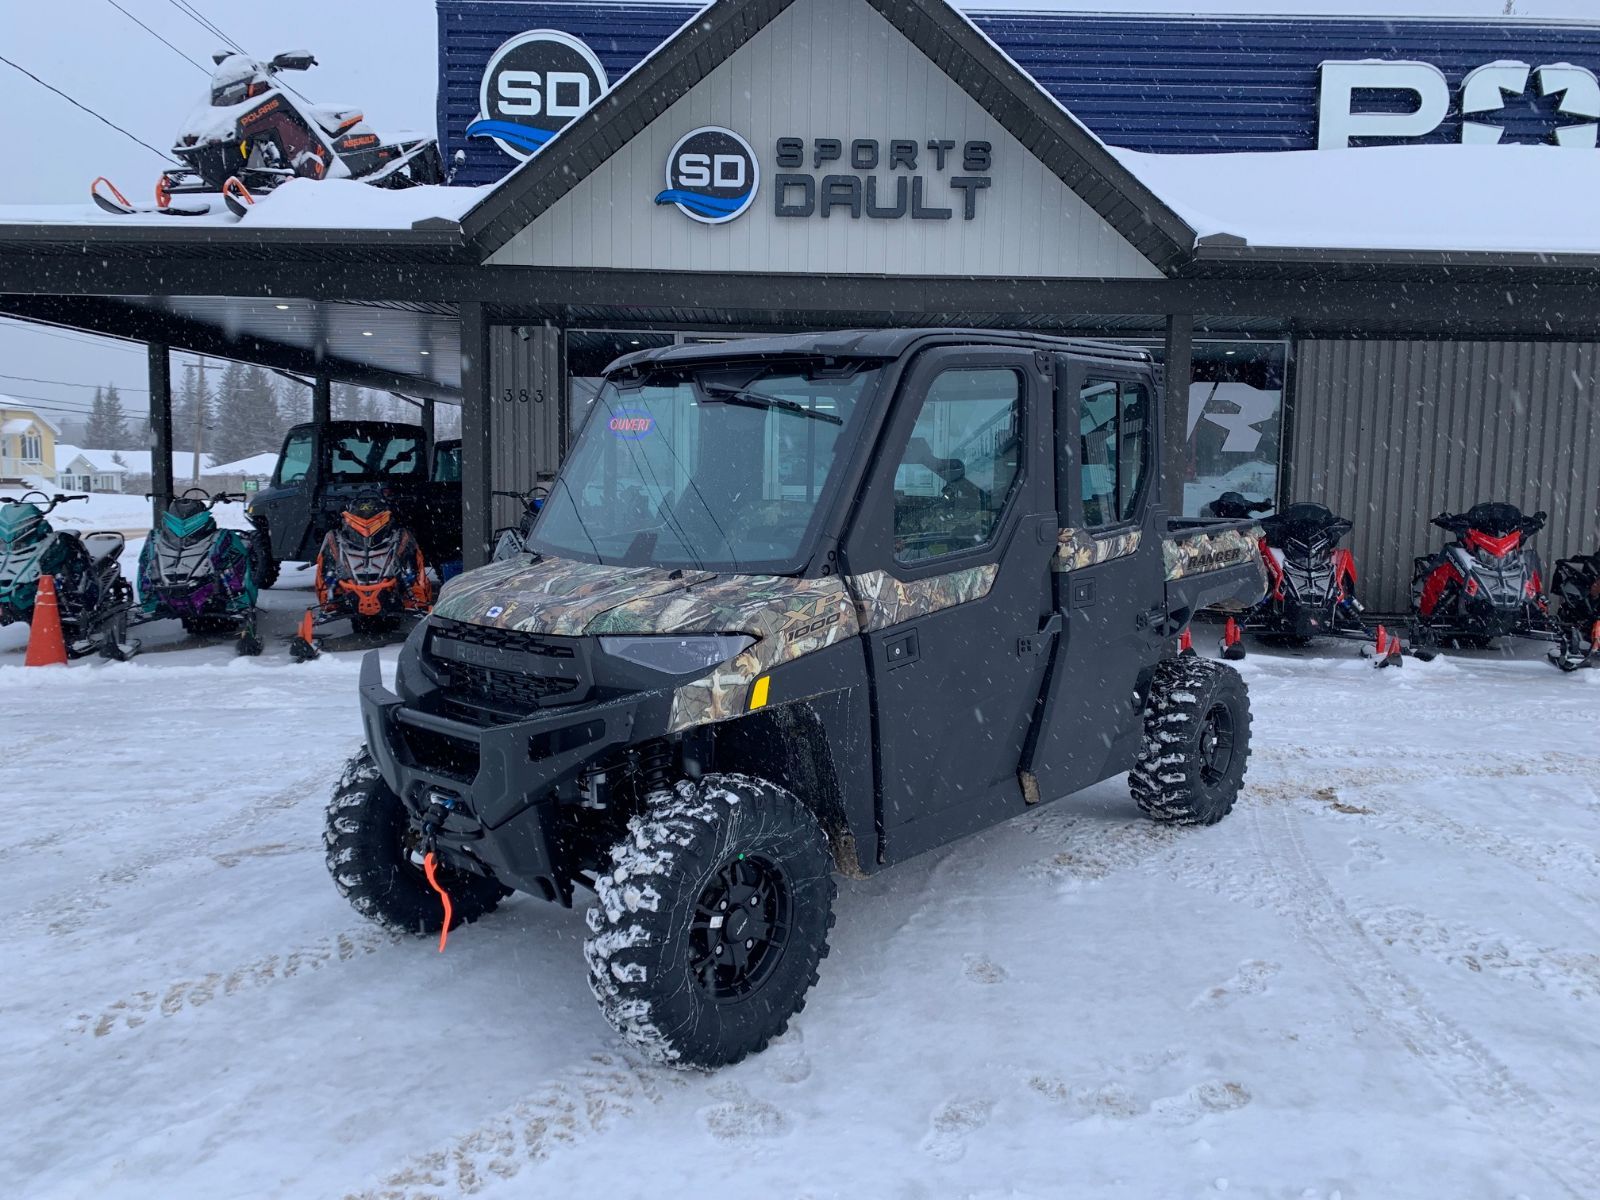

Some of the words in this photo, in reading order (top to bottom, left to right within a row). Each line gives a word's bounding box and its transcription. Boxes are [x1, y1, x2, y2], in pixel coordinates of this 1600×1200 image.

[497, 70, 590, 117] SD
[240, 99, 280, 127] POLARIS
[342, 134, 376, 149] ASSAULT
[775, 137, 992, 171] SPORTS
[678, 153, 746, 188] SD
[774, 173, 992, 221] DAULT
[503, 388, 544, 403] 383
[609, 417, 651, 432] OUVERT
[1187, 548, 1240, 570] RANGER
[780, 591, 845, 631] XP
[787, 611, 841, 642] 1000
